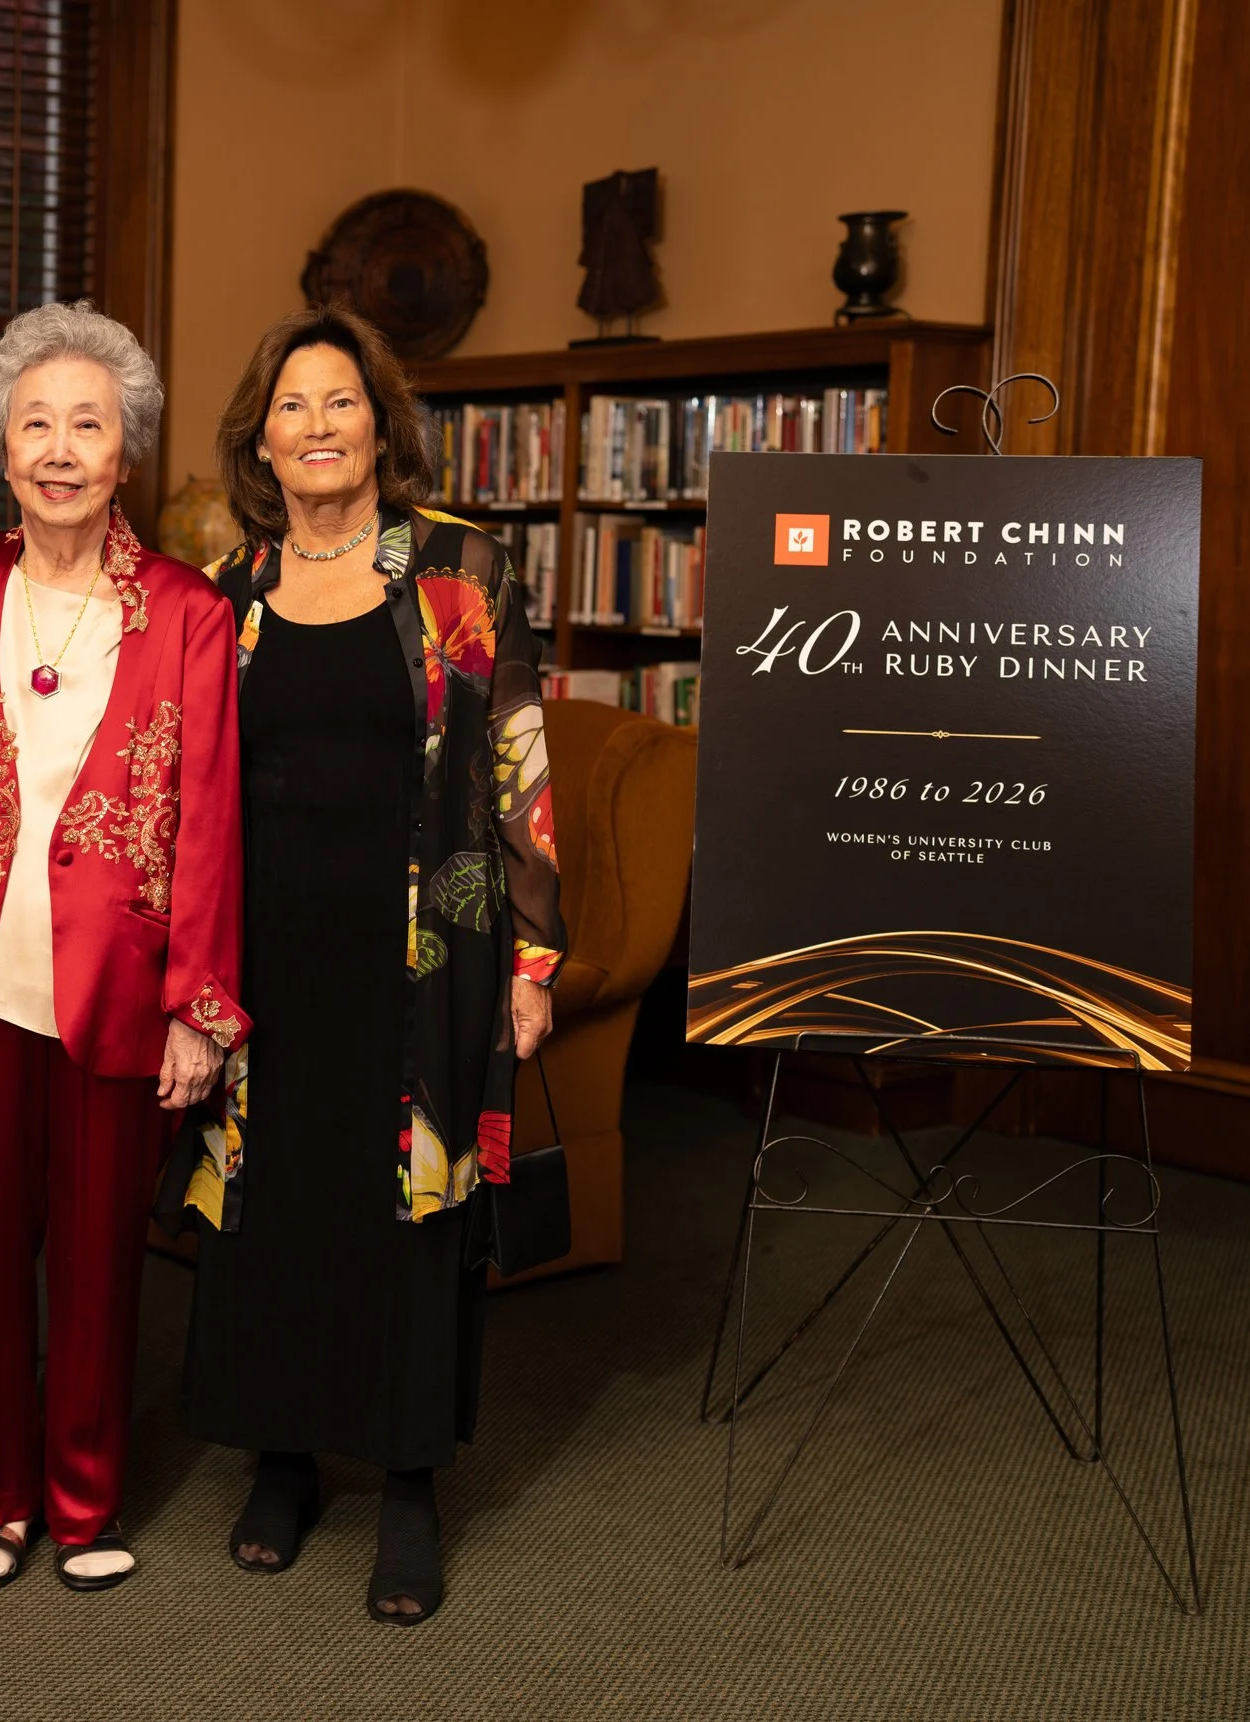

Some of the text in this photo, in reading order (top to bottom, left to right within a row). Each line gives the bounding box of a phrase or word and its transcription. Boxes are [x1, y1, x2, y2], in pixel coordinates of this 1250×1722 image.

[843, 519, 1125, 546] ROBERT CHINN
[843, 548, 1123, 568] FOUNDATION
[881, 620, 1152, 648] ANNIVERSARY
[885, 653, 1148, 682] RUBY DINNER
[834, 776, 1048, 806] 1986 to 2026
[826, 832, 1052, 851] WOMEN'S UNIVERSITY CLUB
[890, 849, 984, 864] OF SEATTLE
